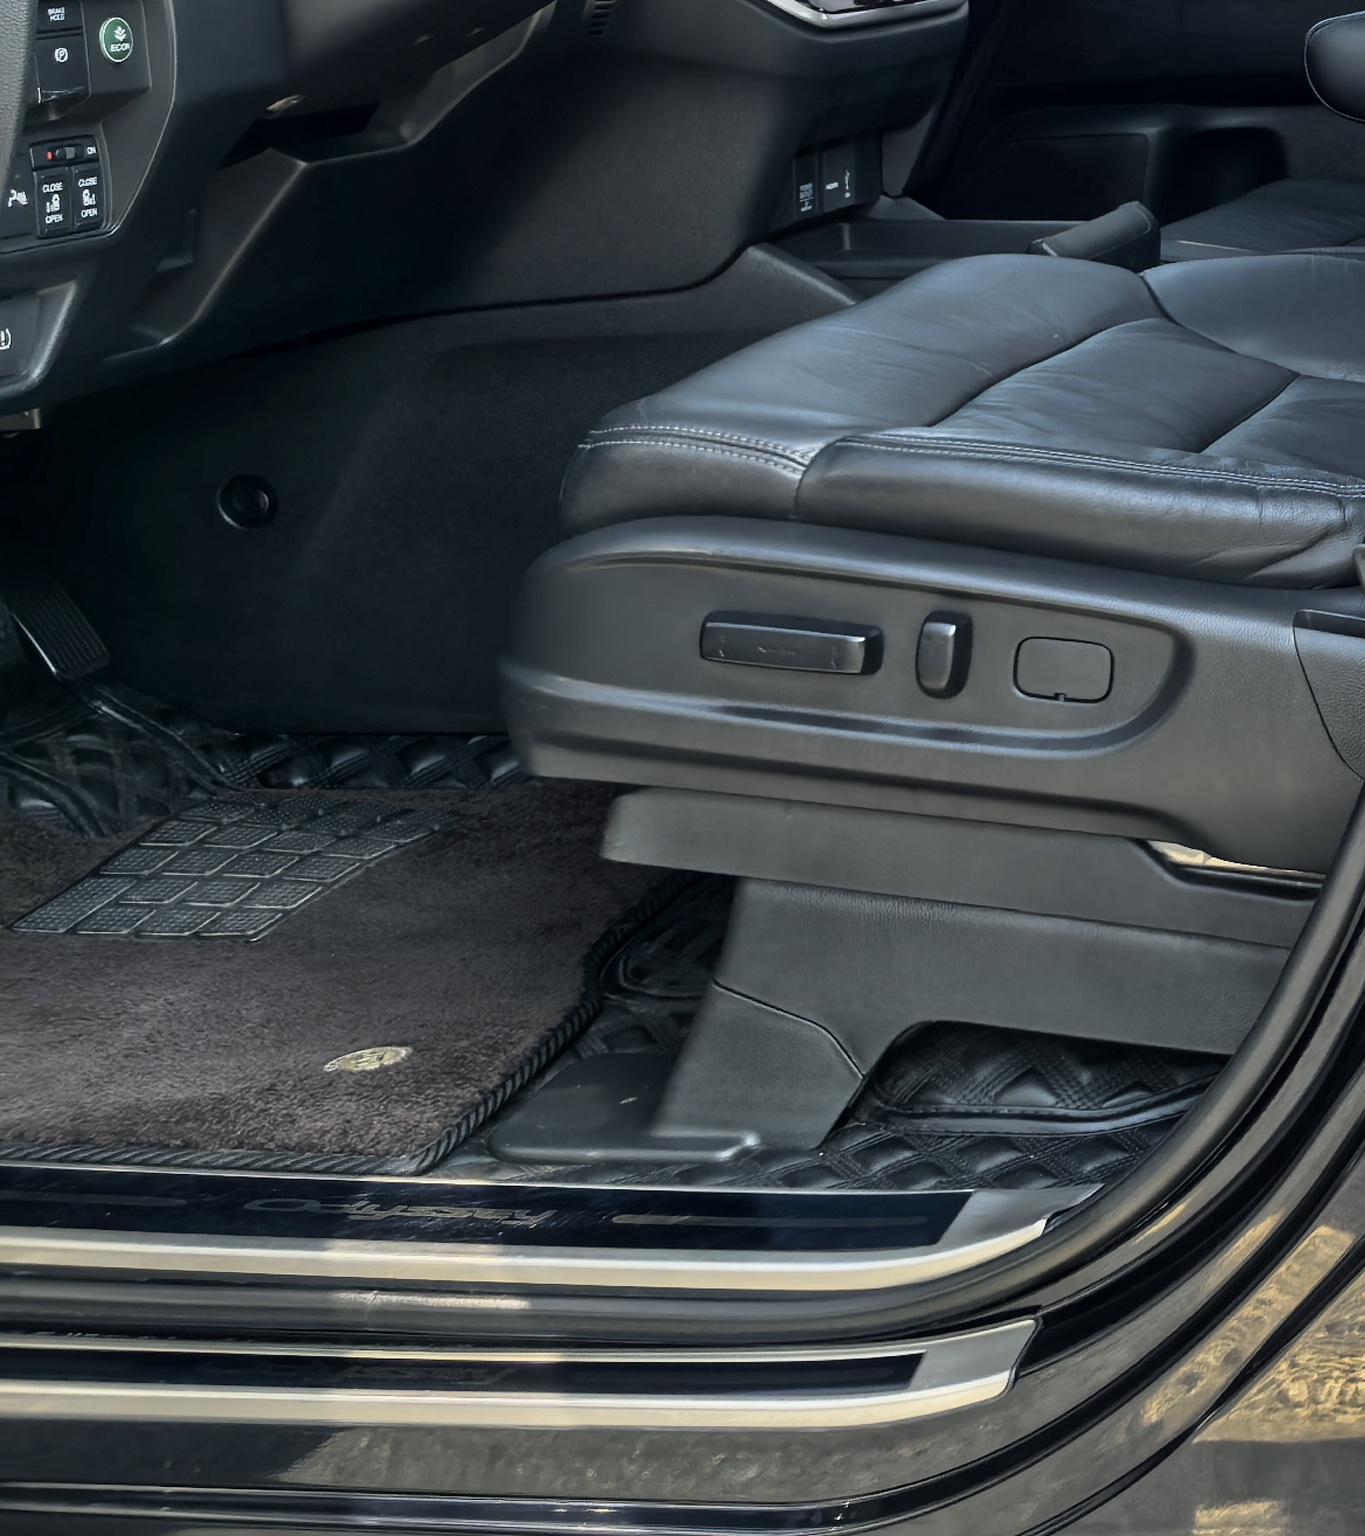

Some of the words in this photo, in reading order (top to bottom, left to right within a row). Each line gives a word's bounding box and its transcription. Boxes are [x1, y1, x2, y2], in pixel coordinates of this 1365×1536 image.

[78, 176, 98, 188] CLOSE
[42, 182, 63, 193] CLOSE
[81, 208, 97, 218] OPEN
[45, 214, 63, 224] OPEN
